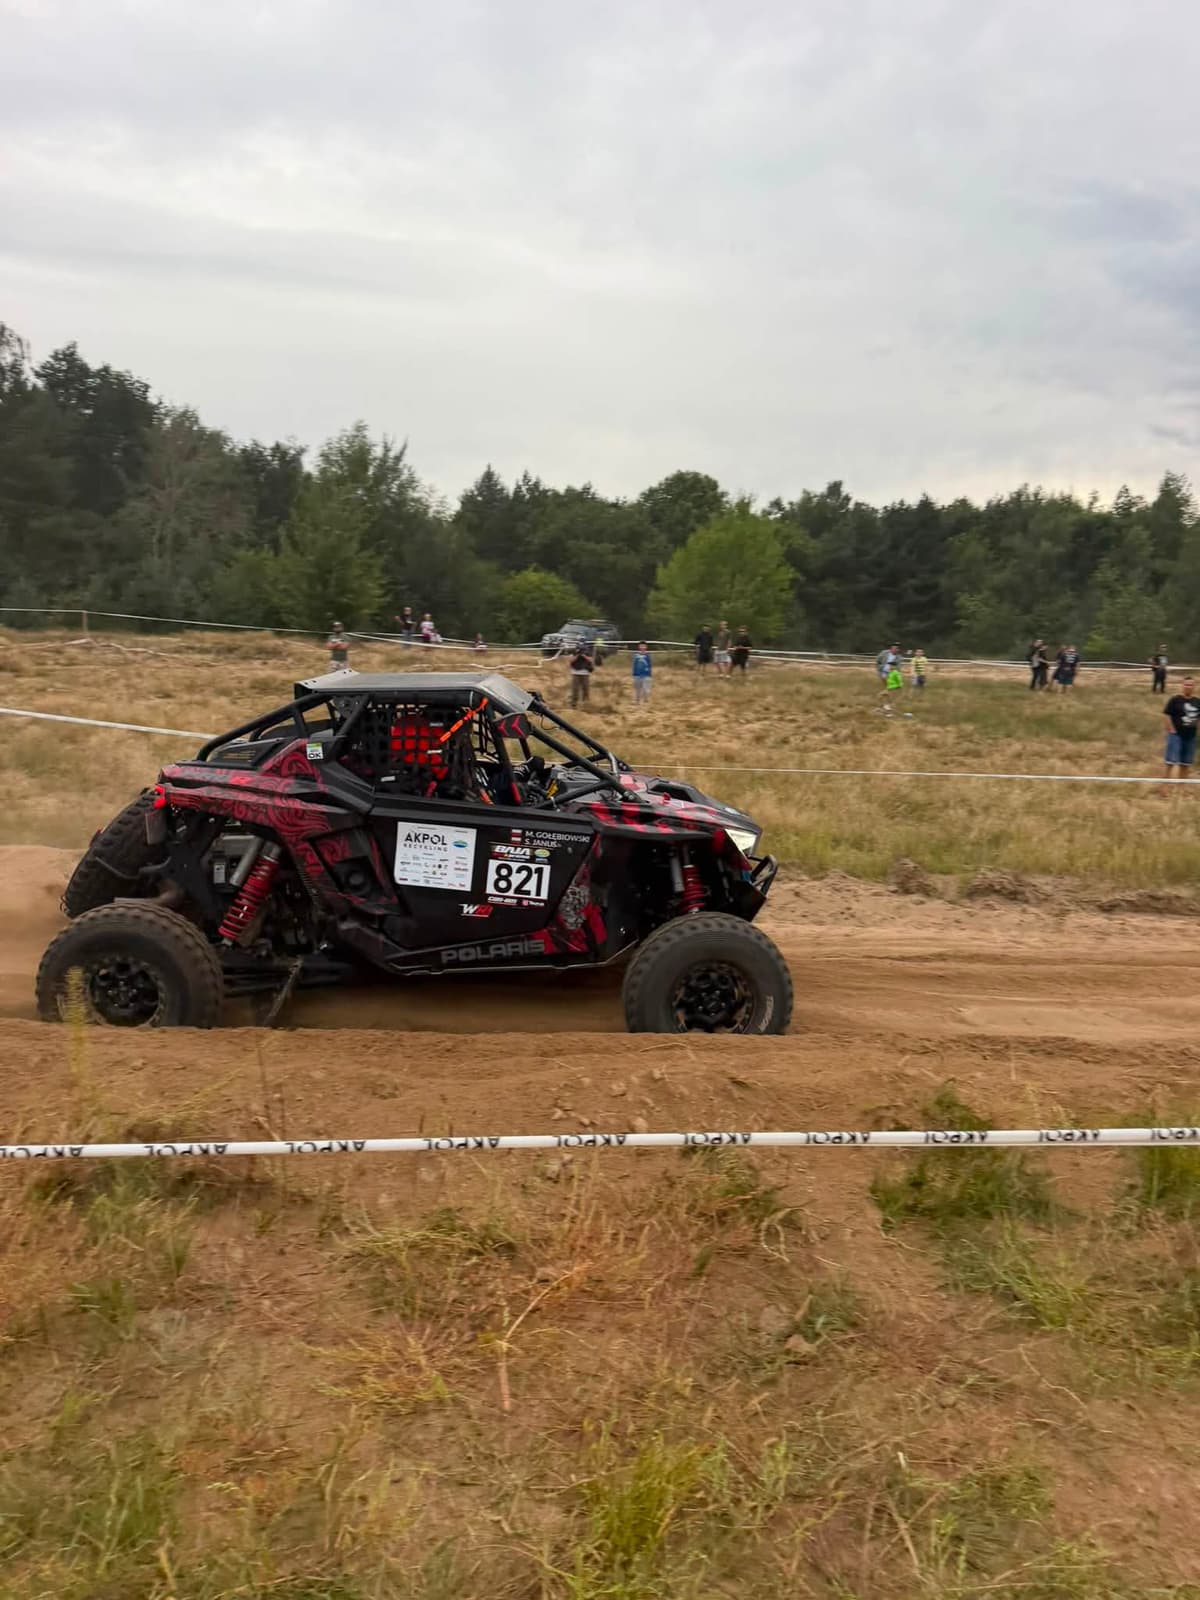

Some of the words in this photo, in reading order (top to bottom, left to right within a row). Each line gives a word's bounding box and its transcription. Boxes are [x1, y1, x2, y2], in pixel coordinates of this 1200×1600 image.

[404, 832, 448, 846] AKPOL
[493, 863, 544, 897] 821
[441, 939, 545, 963] POLARIS
[423, 1138, 500, 1151] AKPOL
[553, 1135, 627, 1148] AKPOL
[683, 1133, 752, 1145] AKPOL
[285, 1140, 367, 1154] AKPOL
